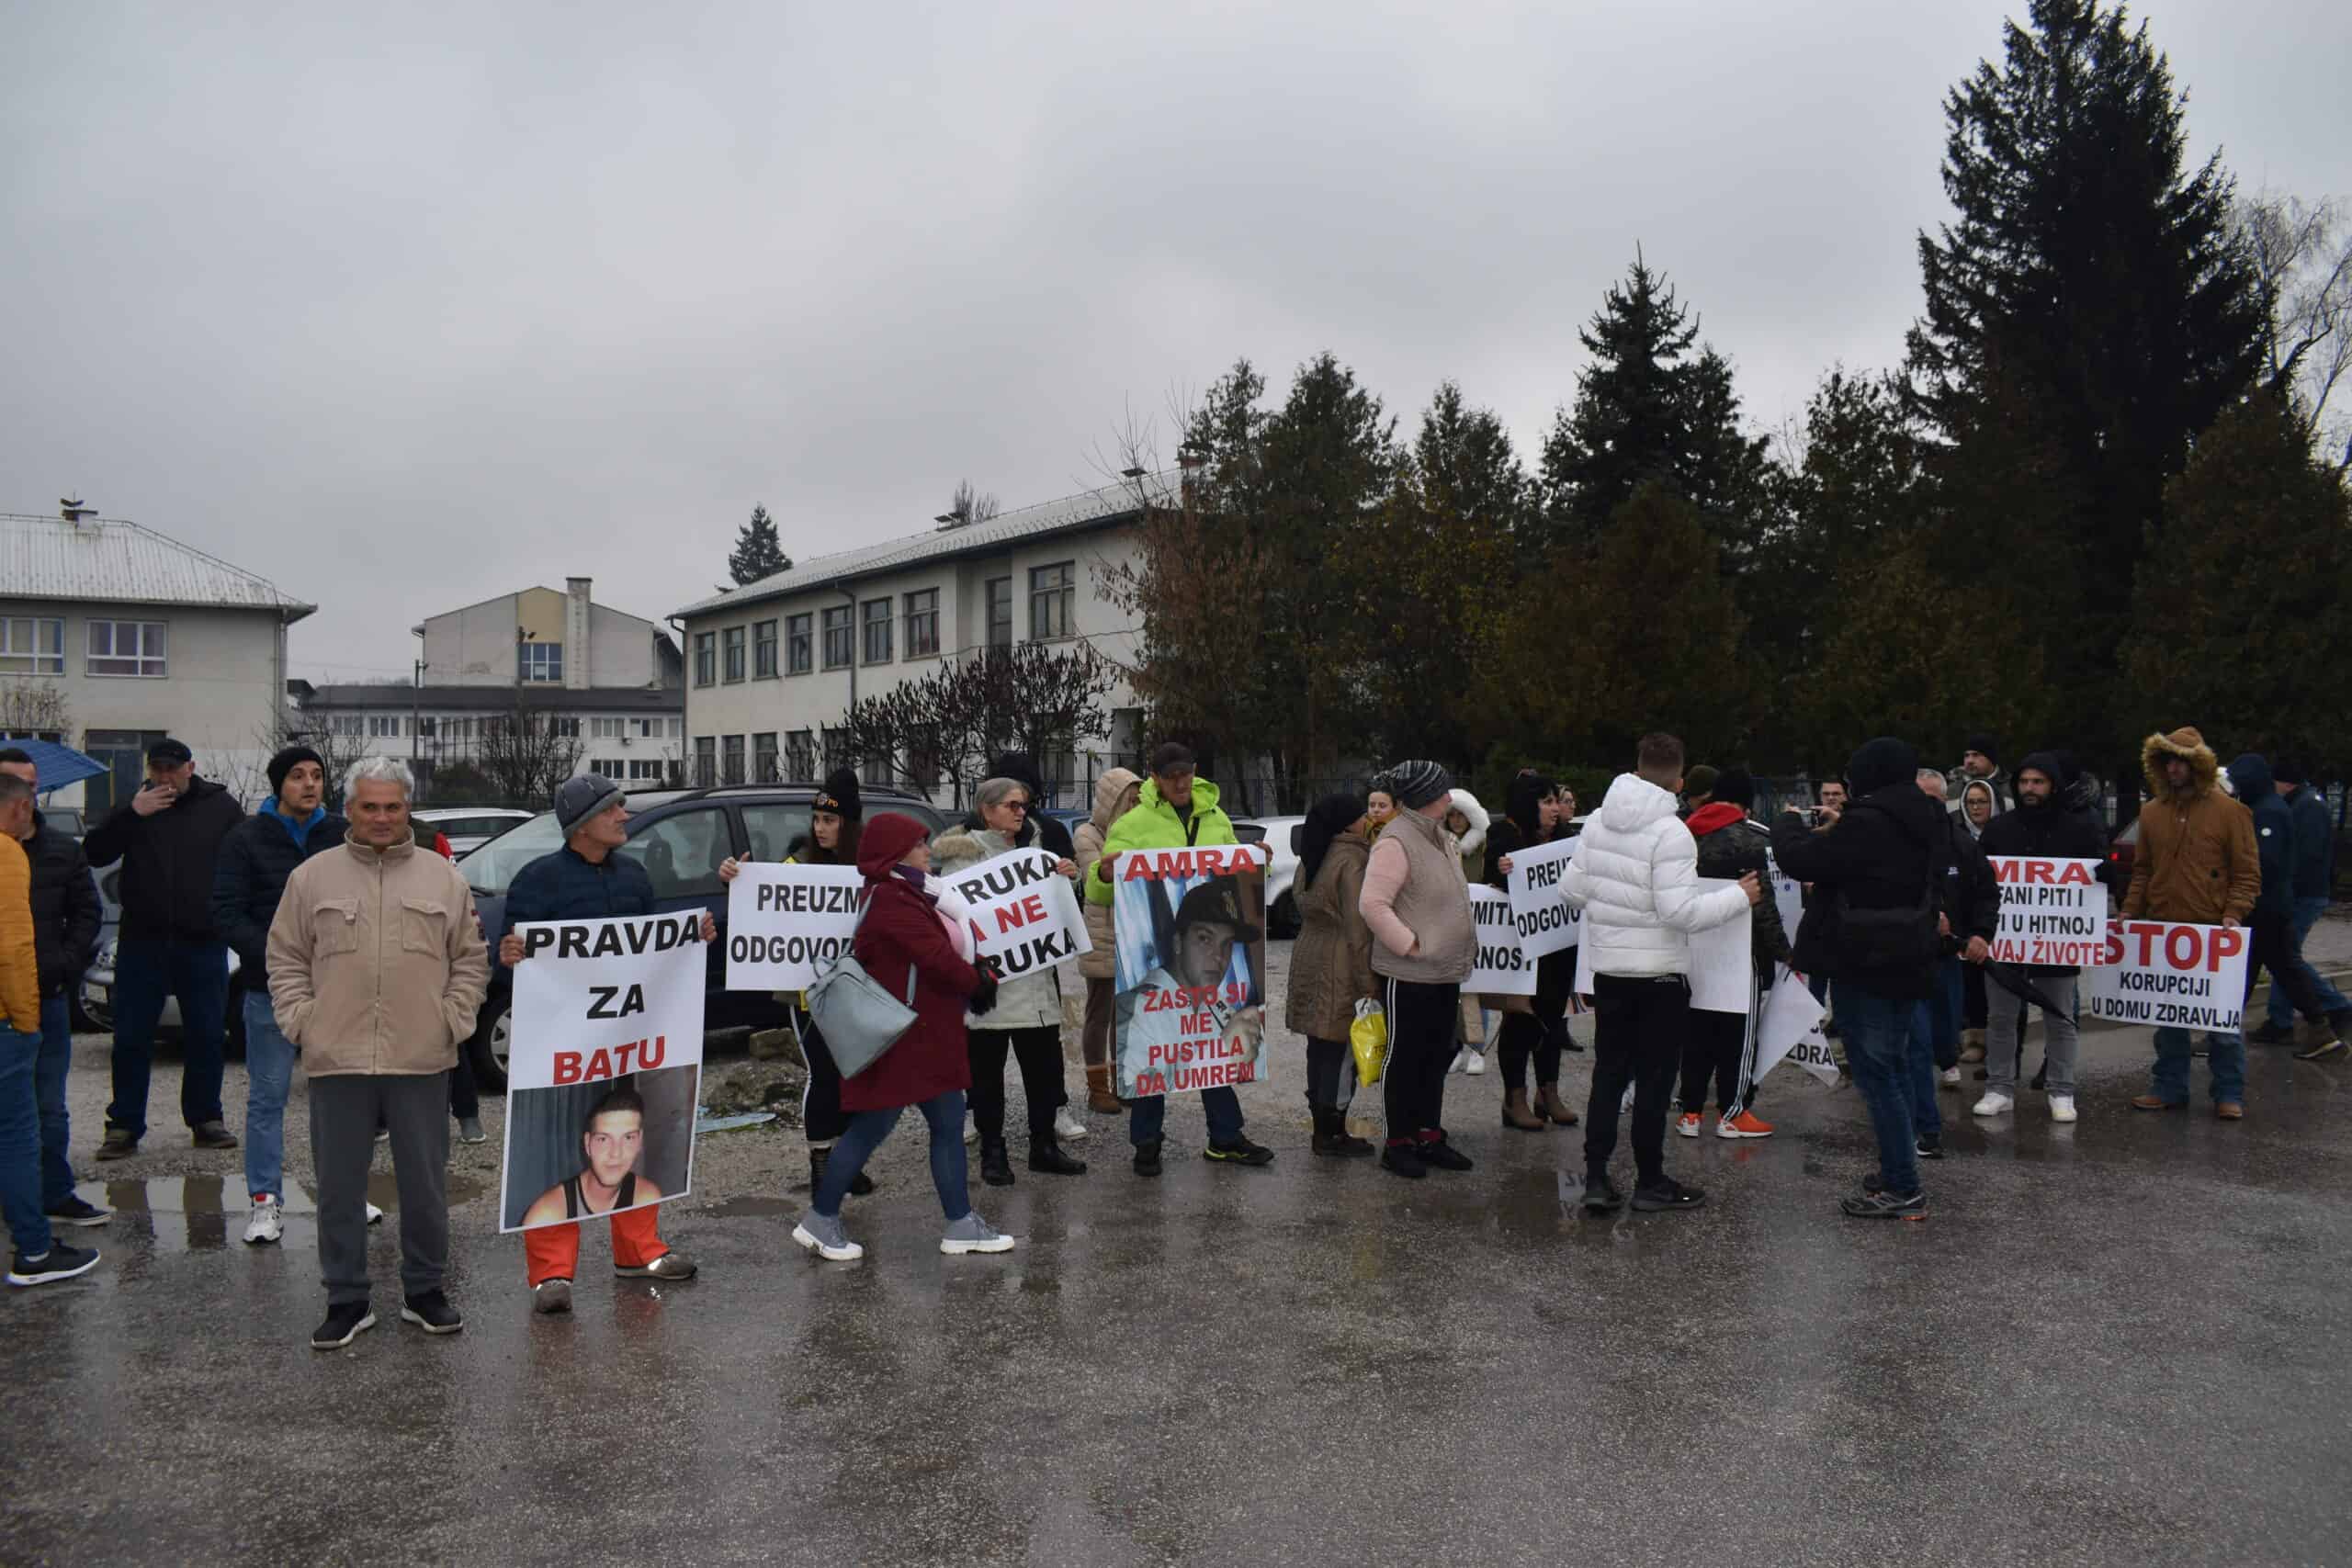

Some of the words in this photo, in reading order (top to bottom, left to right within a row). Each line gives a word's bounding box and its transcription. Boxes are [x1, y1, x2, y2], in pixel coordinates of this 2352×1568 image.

[952, 853, 1058, 905] RUKA
[1124, 848, 1258, 882] AMRA
[1526, 856, 1573, 891] PREU
[994, 893, 1048, 934] NE
[2039, 887, 2072, 907] PITI
[2078, 888, 2084, 908] I
[525, 914, 701, 959] PRAVDA
[2012, 914, 2023, 932] U
[2030, 915, 2095, 935] HITNOJ
[1474, 945, 1532, 972] NOS
[2032, 934, 2104, 965] ŽIVOTE
[2104, 920, 2243, 973] STOP
[1143, 985, 1218, 1013] ZAŠTO
[1226, 984, 1248, 1005] SI
[2120, 971, 2211, 998] KORUPCIJI
[587, 984, 645, 1020] ZA
[2092, 997, 2101, 1015] U
[2105, 998, 2151, 1020] DOMU
[2155, 1002, 2240, 1030] ZDRAVLJA
[1181, 1013, 1213, 1035] ME
[553, 1036, 665, 1086] BATU
[1148, 1036, 1244, 1066] PUSTILA
[1785, 1043, 1838, 1066] ZDRA
[1136, 1072, 1166, 1096] DA
[1175, 1061, 1255, 1090] UMREM
